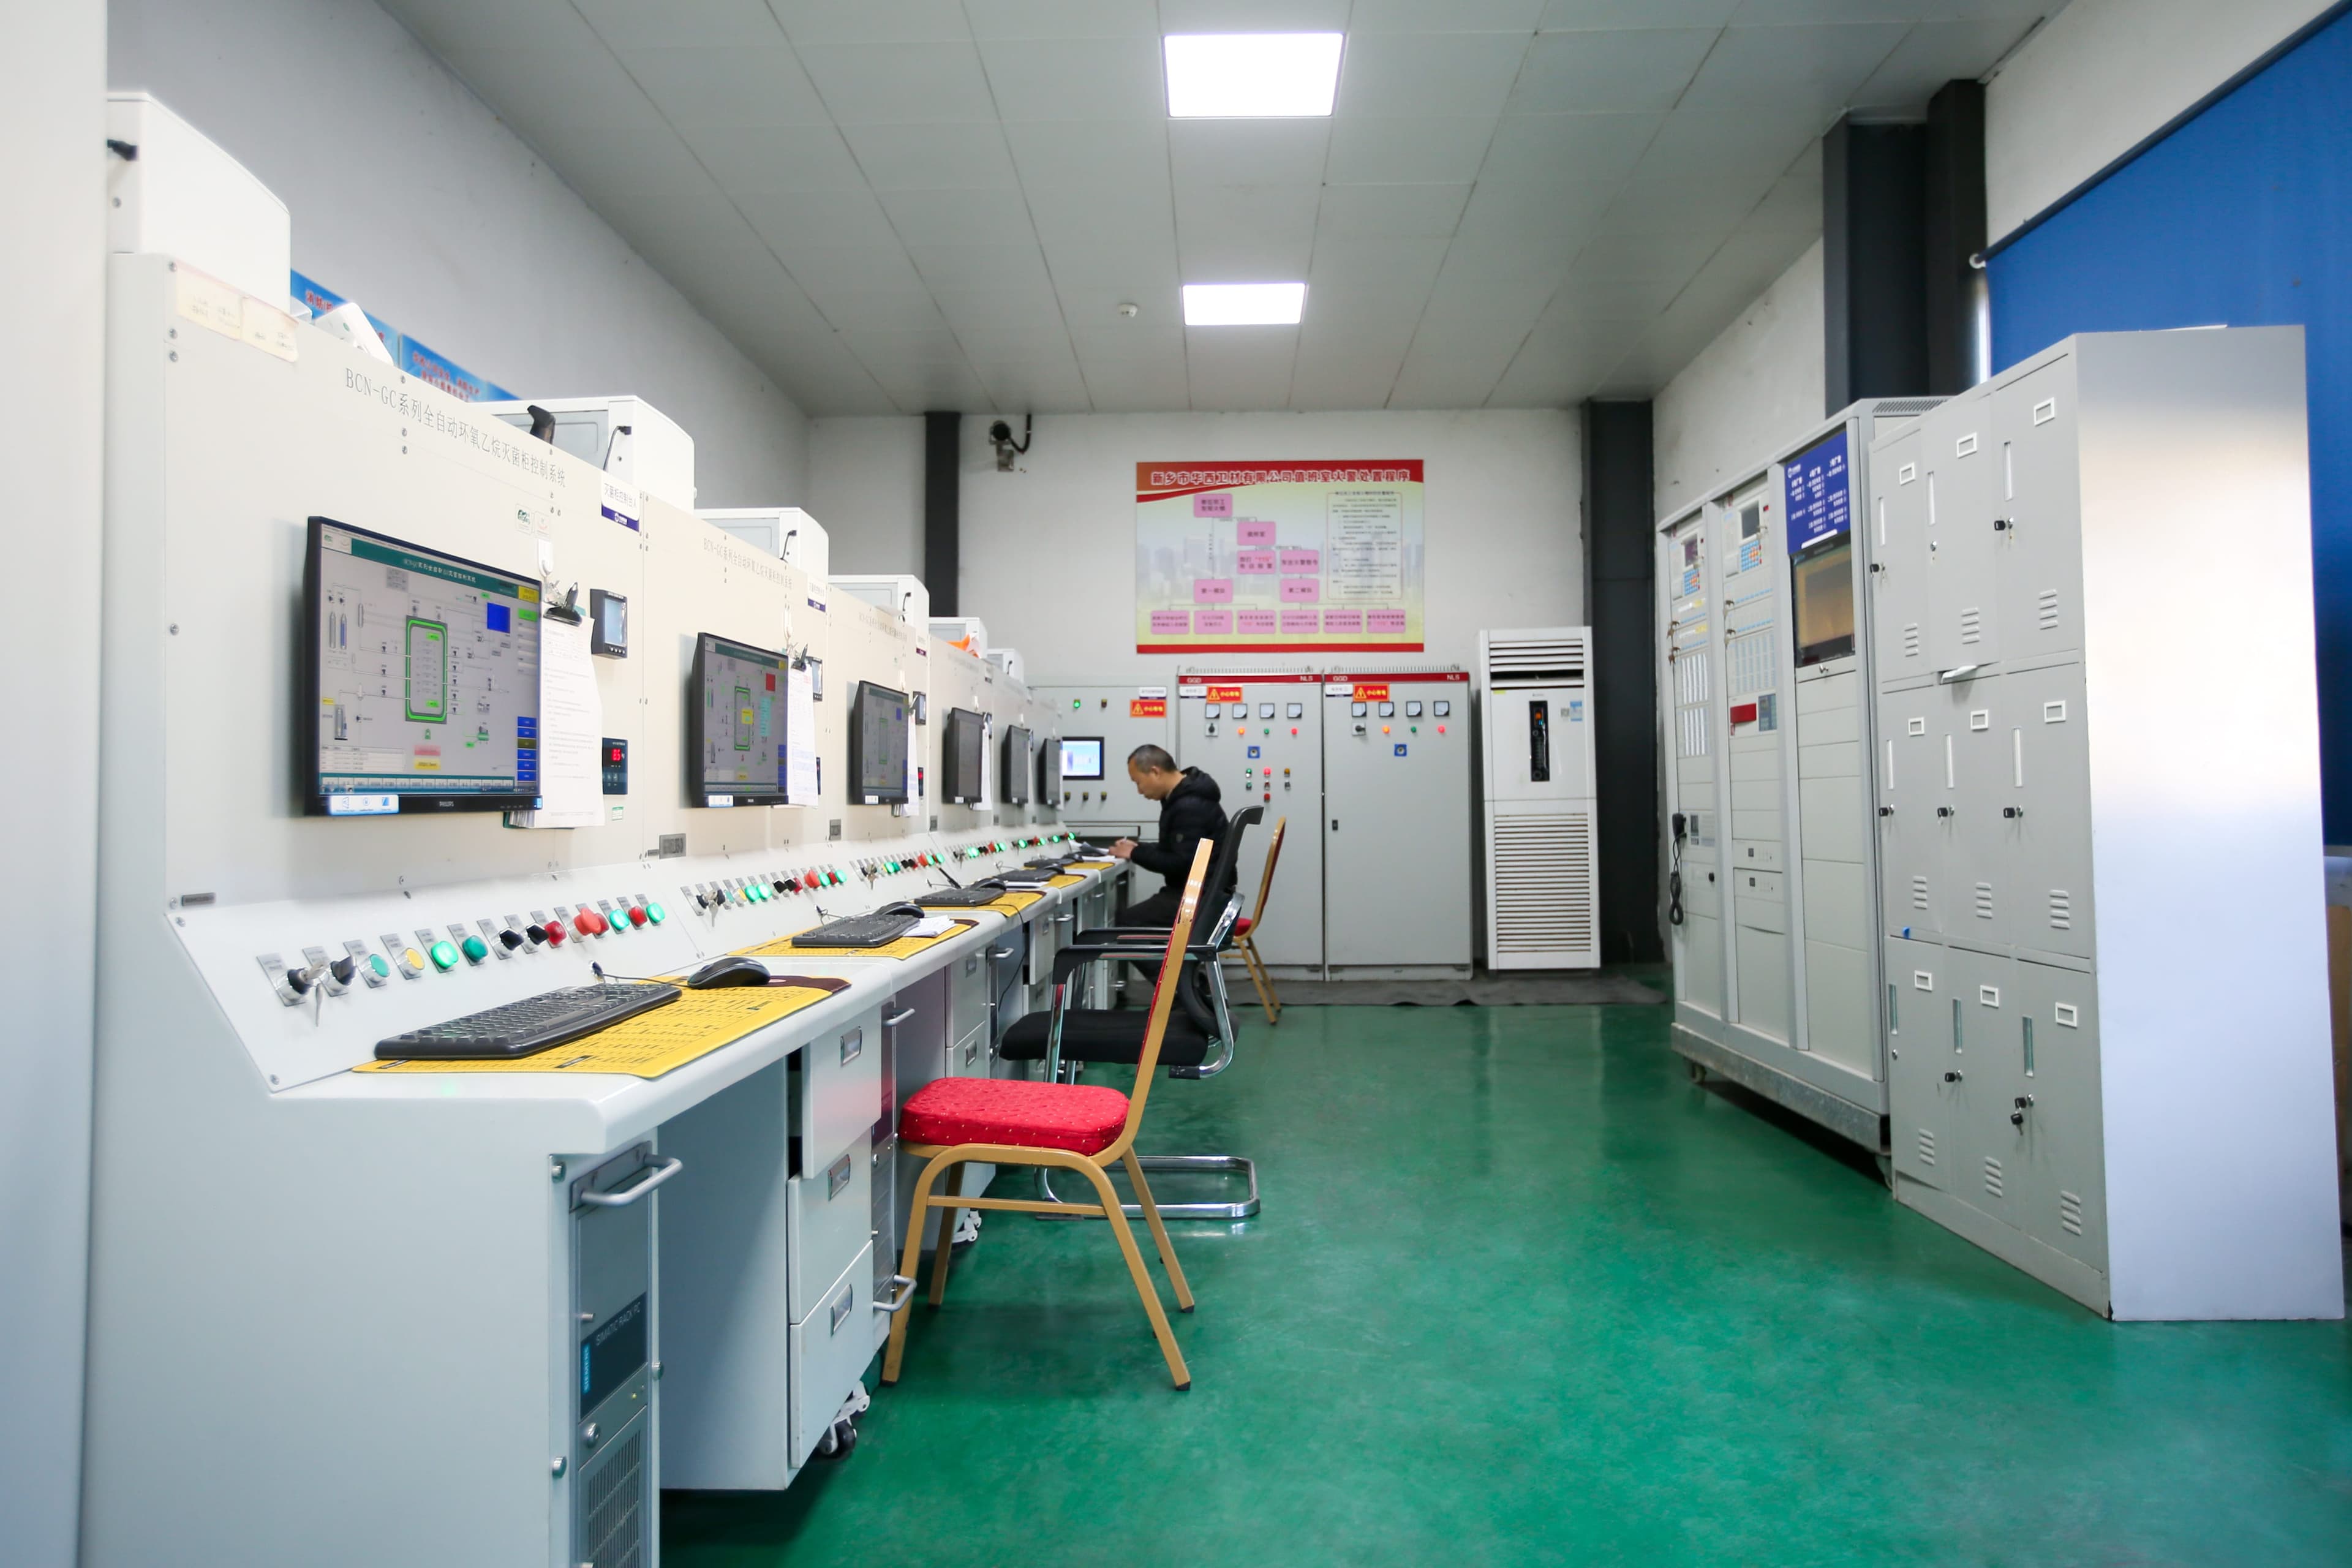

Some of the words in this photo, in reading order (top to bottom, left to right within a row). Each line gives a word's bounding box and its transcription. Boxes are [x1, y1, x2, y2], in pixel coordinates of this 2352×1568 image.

[345, 368, 566, 488] BCN-GC系列全自动环氧乙烷灭菌柜控制系统
[1151, 469, 1411, 486] 新乡市华西卫材有限公司值班室火警处置程序
[597, 1321, 618, 1346] SIMATIC
[619, 1310, 633, 1325] RACK
